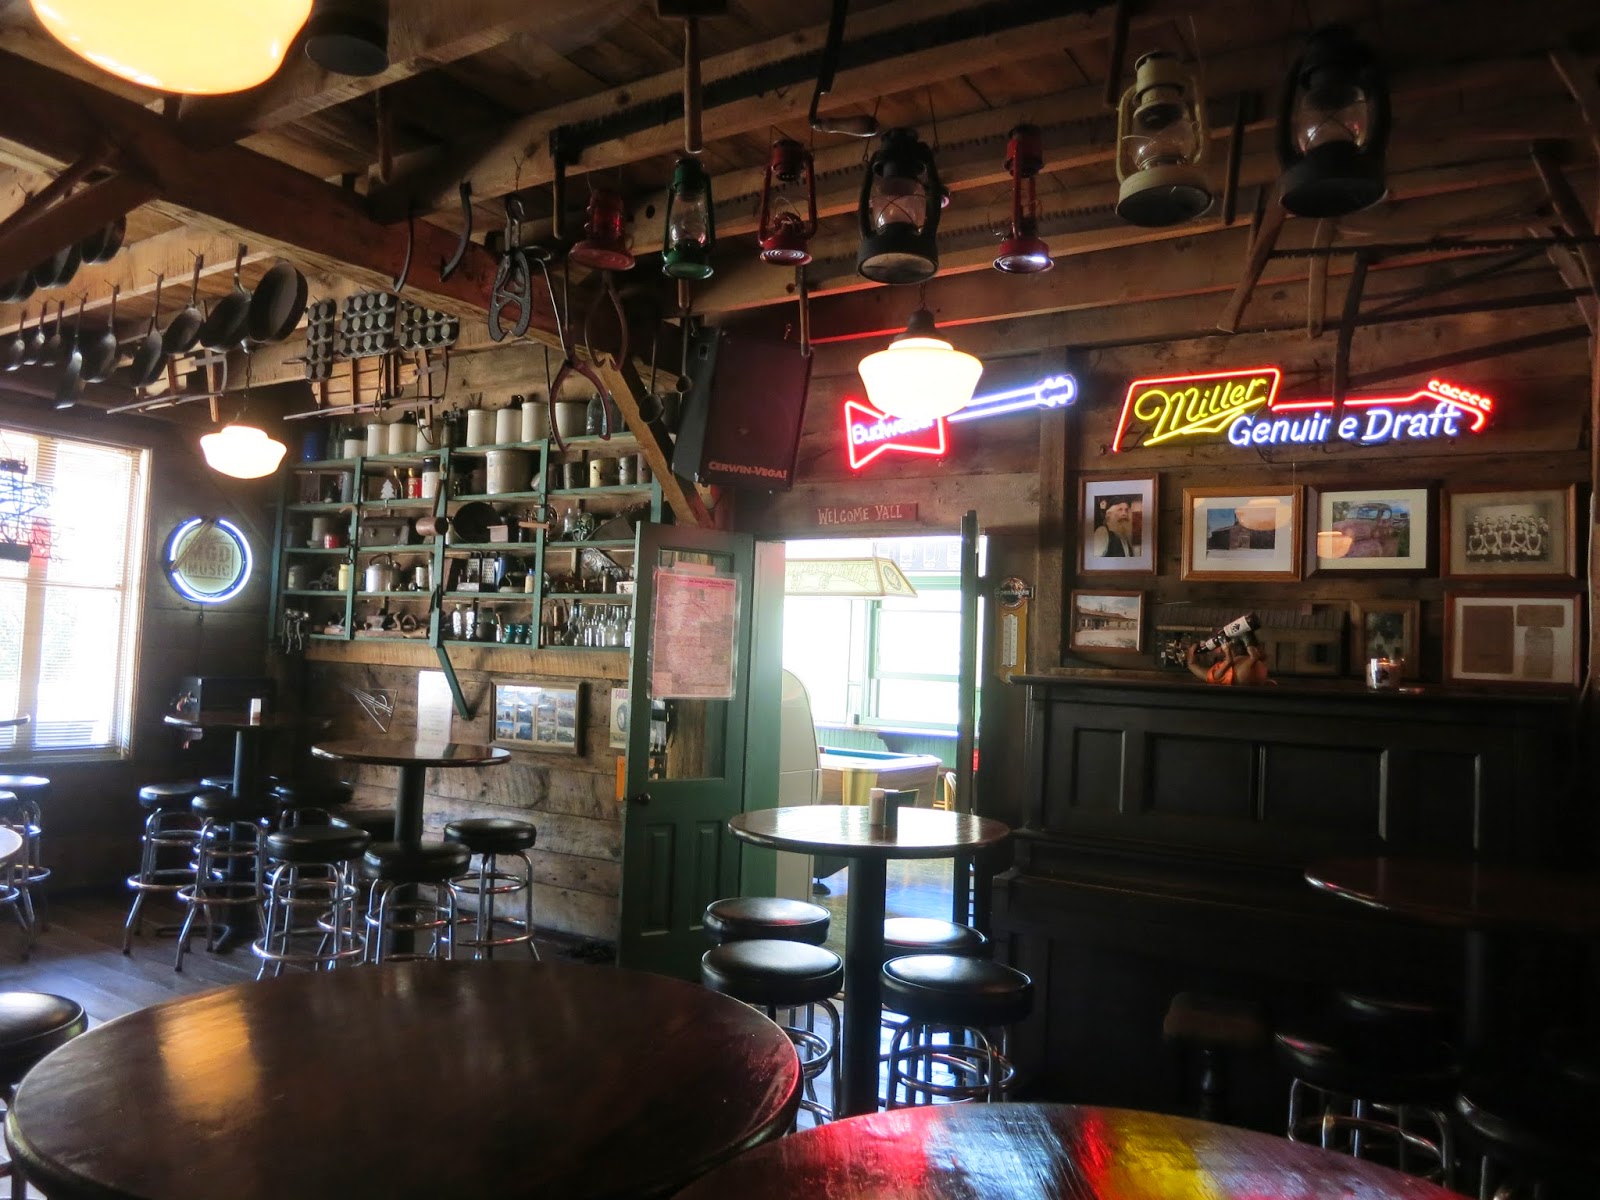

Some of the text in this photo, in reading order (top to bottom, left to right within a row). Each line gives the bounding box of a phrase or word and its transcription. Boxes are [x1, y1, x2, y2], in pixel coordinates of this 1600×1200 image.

[1134, 378, 1267, 440] Miller
[1361, 402, 1461, 441] Draft
[817, 504, 903, 525] WELCOME YALL
[187, 563, 230, 576] MUSIC
